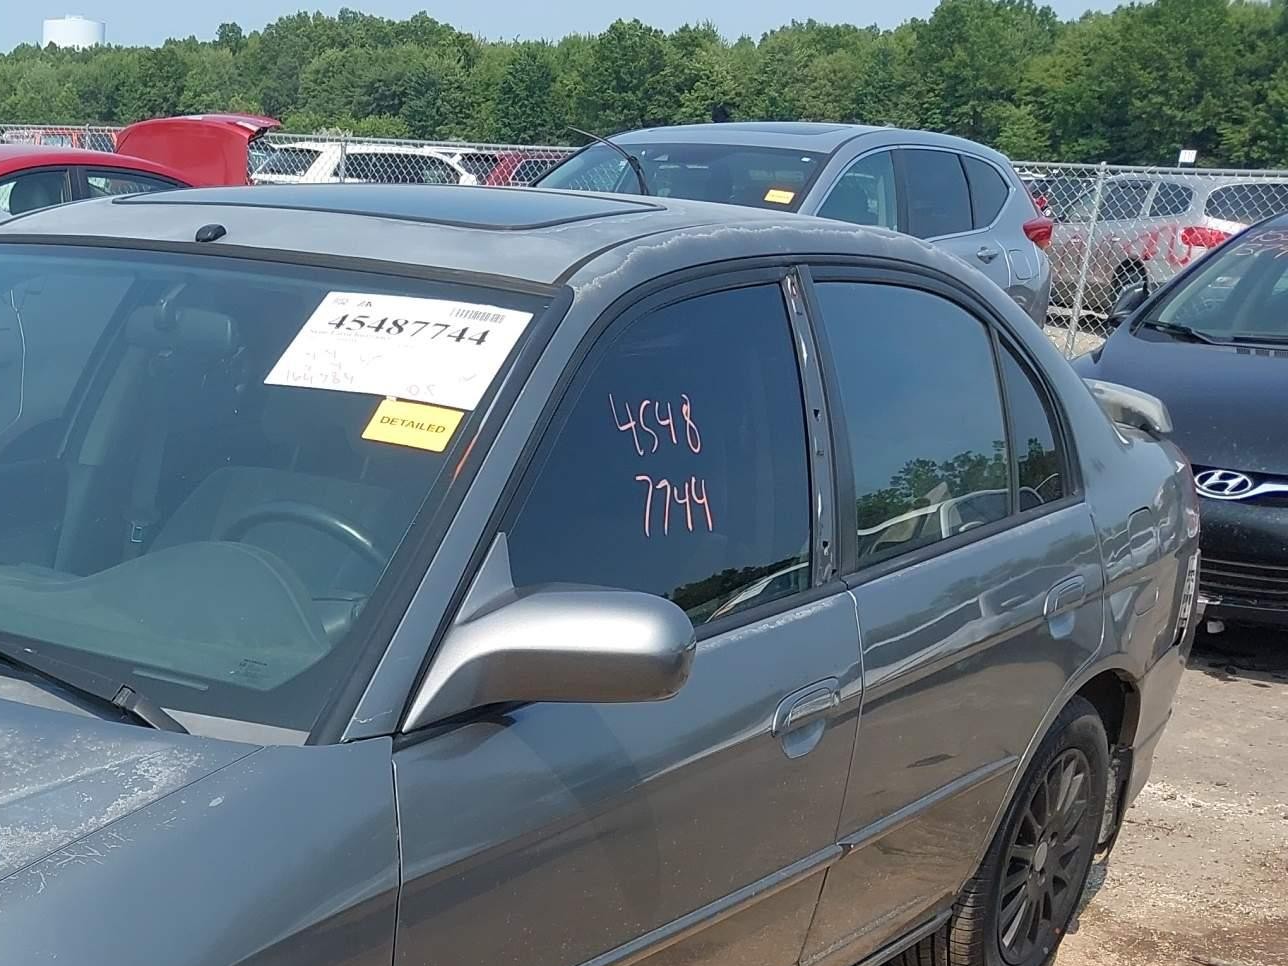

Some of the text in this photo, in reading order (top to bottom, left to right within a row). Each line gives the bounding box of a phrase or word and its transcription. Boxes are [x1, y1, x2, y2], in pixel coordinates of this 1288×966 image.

[328, 313, 490, 346] 45487744
[380, 416, 446, 433] DETAILED
[609, 393, 701, 456] 4548
[635, 476, 713, 537] 7744
